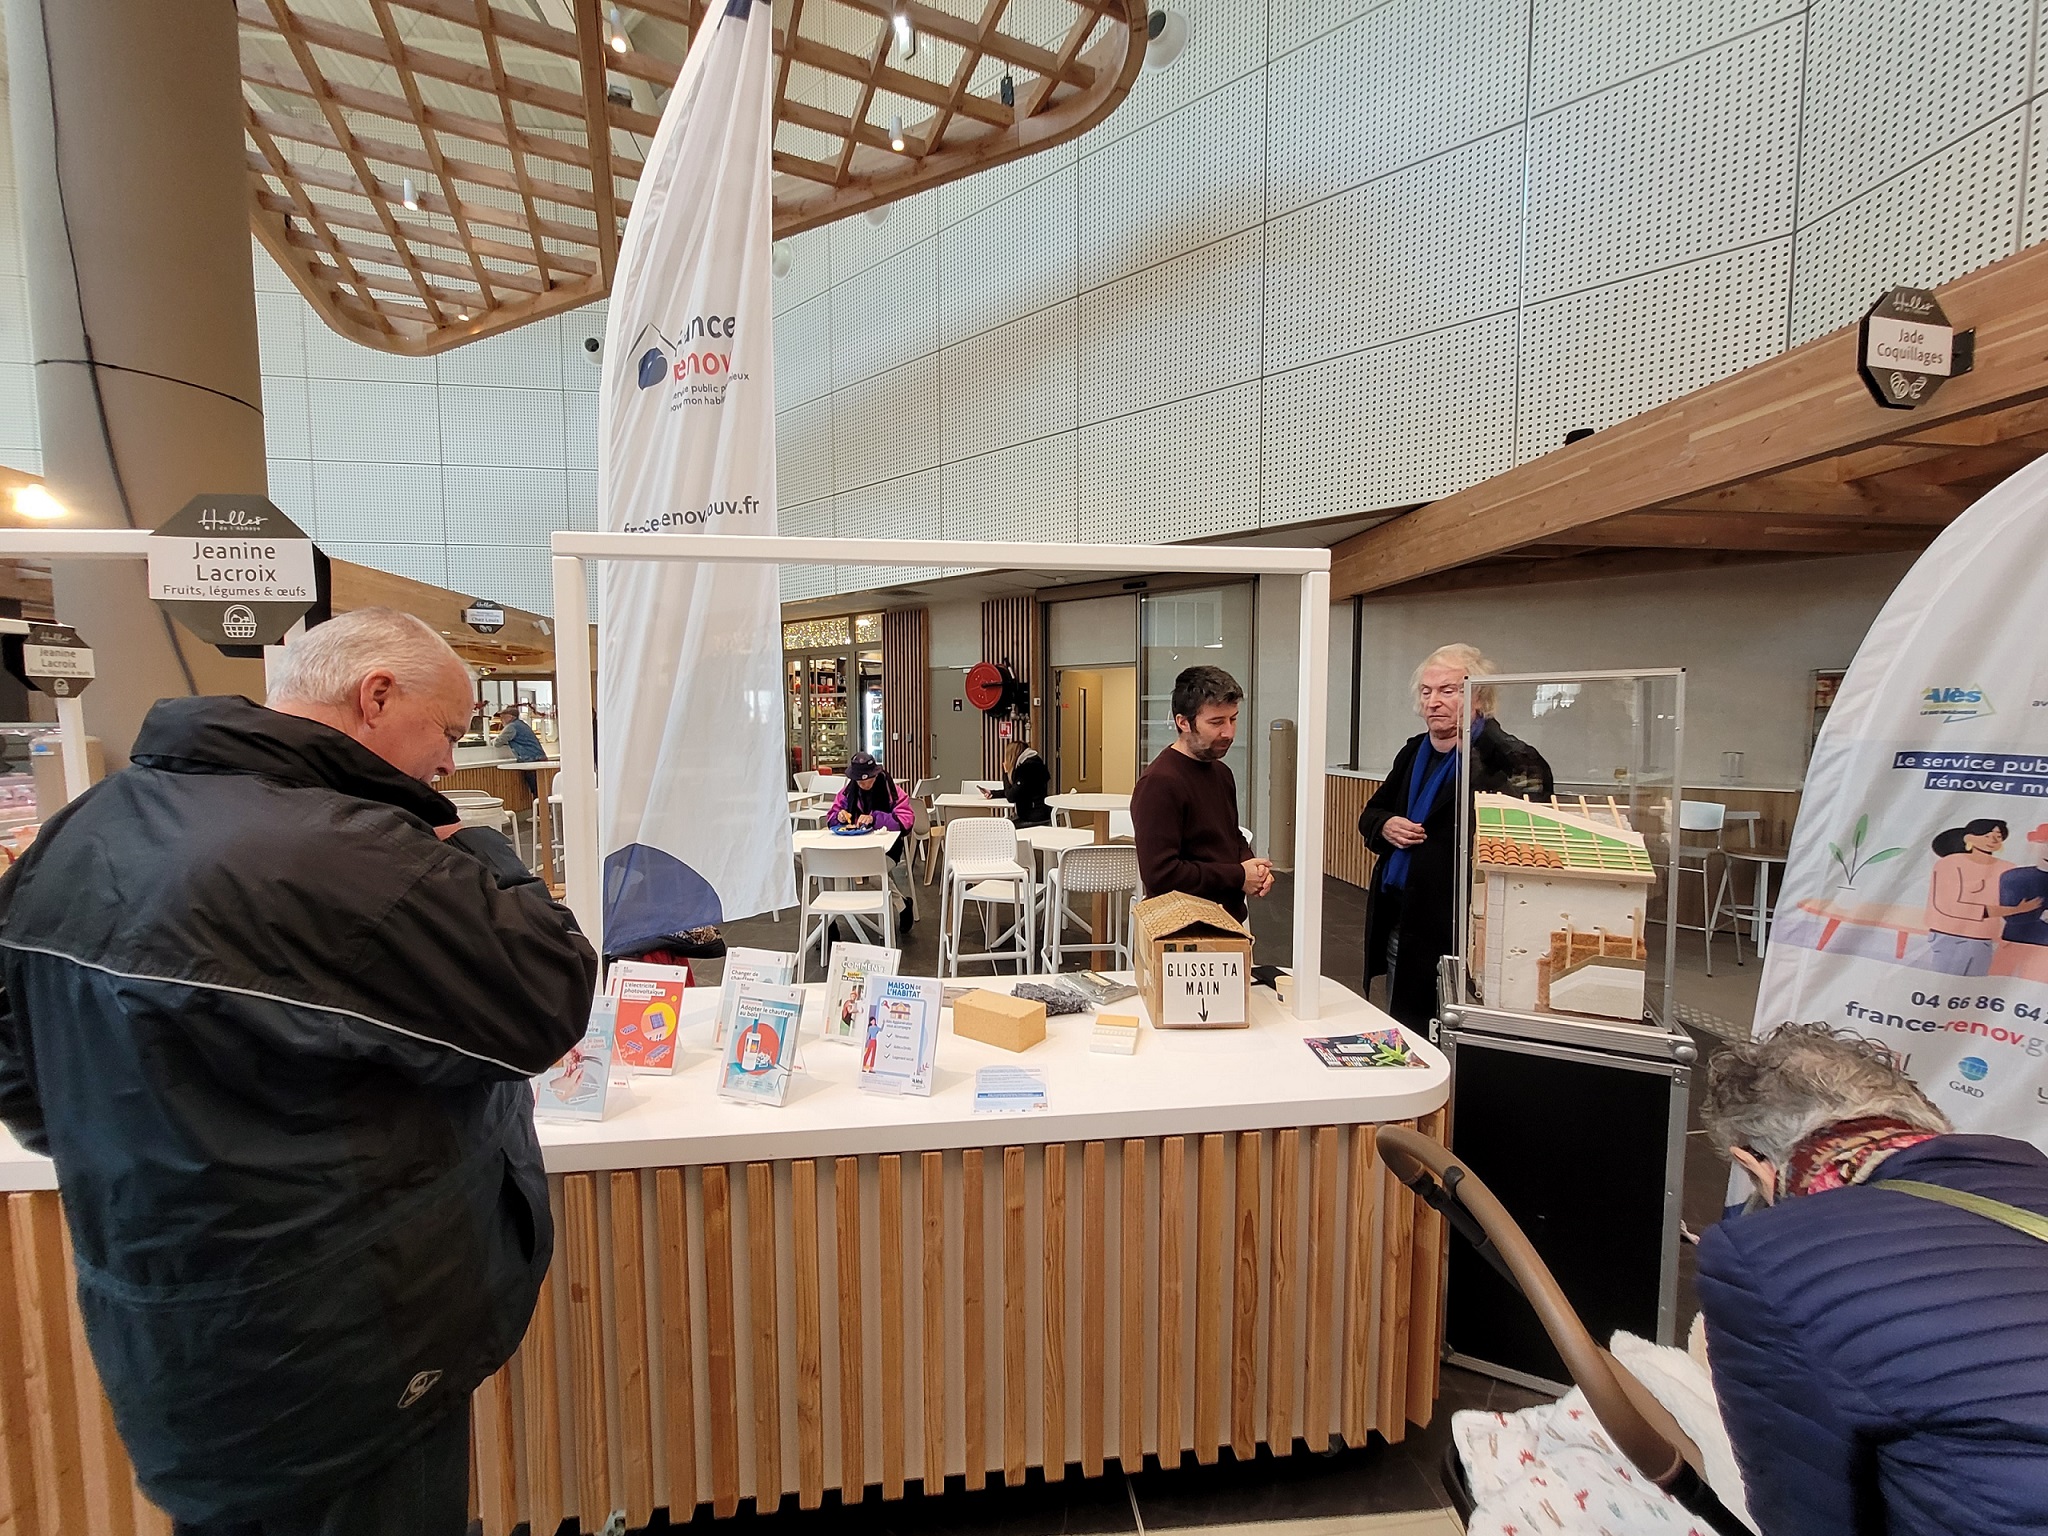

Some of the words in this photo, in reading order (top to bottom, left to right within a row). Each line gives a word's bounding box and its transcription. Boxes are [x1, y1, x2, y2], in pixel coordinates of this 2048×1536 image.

[1898, 328, 1925, 344] Jade
[1877, 343, 1943, 366] Coquillages
[691, 384, 719, 394] public
[198, 509, 269, 530] Halles
[193, 542, 276, 560] Jeanine
[196, 565, 277, 582] Lacroix
[163, 585, 206, 597] Fruits,
[209, 586, 260, 598] légumes
[263, 587, 273, 596] &
[276, 586, 306, 597] œufs
[41, 659, 77, 668] Lacroix
[1896, 753, 1916, 767] Le
[1922, 755, 1996, 770] service
[1929, 775, 2015, 792] rénover
[1166, 962, 1215, 977] GLISSE
[1222, 962, 1238, 977] TA
[887, 989, 921, 998] L'HABITAT
[888, 981, 915, 990] MAISON
[1185, 981, 1220, 995] MAIN
[740, 1004, 763, 1012] Adopter
[769, 1008, 794, 1018] chauffage
[1911, 992, 1941, 1008] 04
[1947, 997, 1972, 1009] 66
[1974, 996, 2006, 1012] 86
[2014, 1003, 2042, 1021] 64
[1949, 1080, 1985, 1099] GARD
